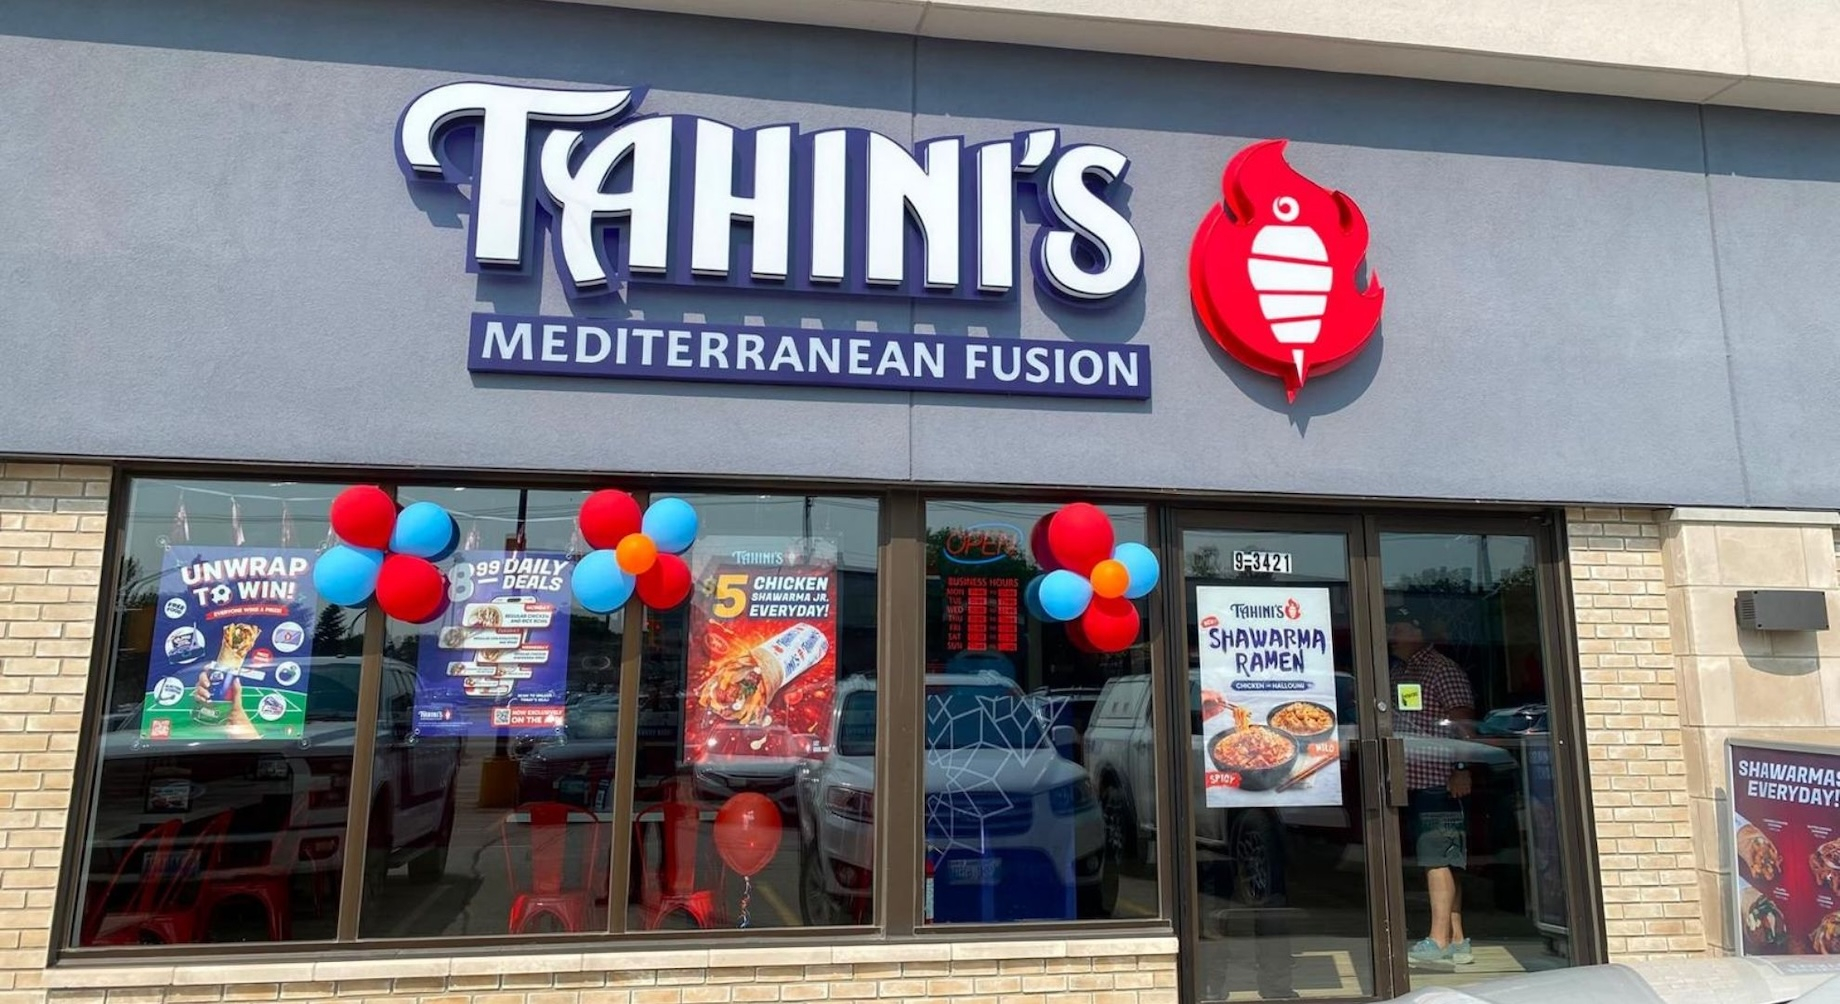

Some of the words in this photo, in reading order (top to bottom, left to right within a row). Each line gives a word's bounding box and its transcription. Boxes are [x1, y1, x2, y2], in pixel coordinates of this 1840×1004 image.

[399, 82, 1143, 300] TAHINI'S
[480, 320, 945, 380] MEDITERRANEAN
[965, 343, 1140, 387] FUSION
[946, 530, 1018, 558] OPEN
[181, 556, 308, 586] UNWRAP
[503, 557, 569, 576] DAILY
[1235, 552, 1290, 572] 9-3421
[238, 579, 296, 600] WIN!
[502, 574, 563, 592] DEALS
[753, 576, 829, 592] CHICKEN
[989, 578, 1019, 588] HOURS
[751, 592, 811, 602] SHAWARMA
[813, 592, 829, 603] JR.
[749, 604, 830, 618] EVERYDAY!
[1229, 603, 1284, 619] TAHINI'S
[1209, 627, 1326, 655] SHAWARMA
[1235, 649, 1304, 678] RAMEN
[1316, 743, 1335, 753] MILD
[1210, 774, 1236, 784] SPICY
[1748, 779, 1840, 808] EVERYDAY!
